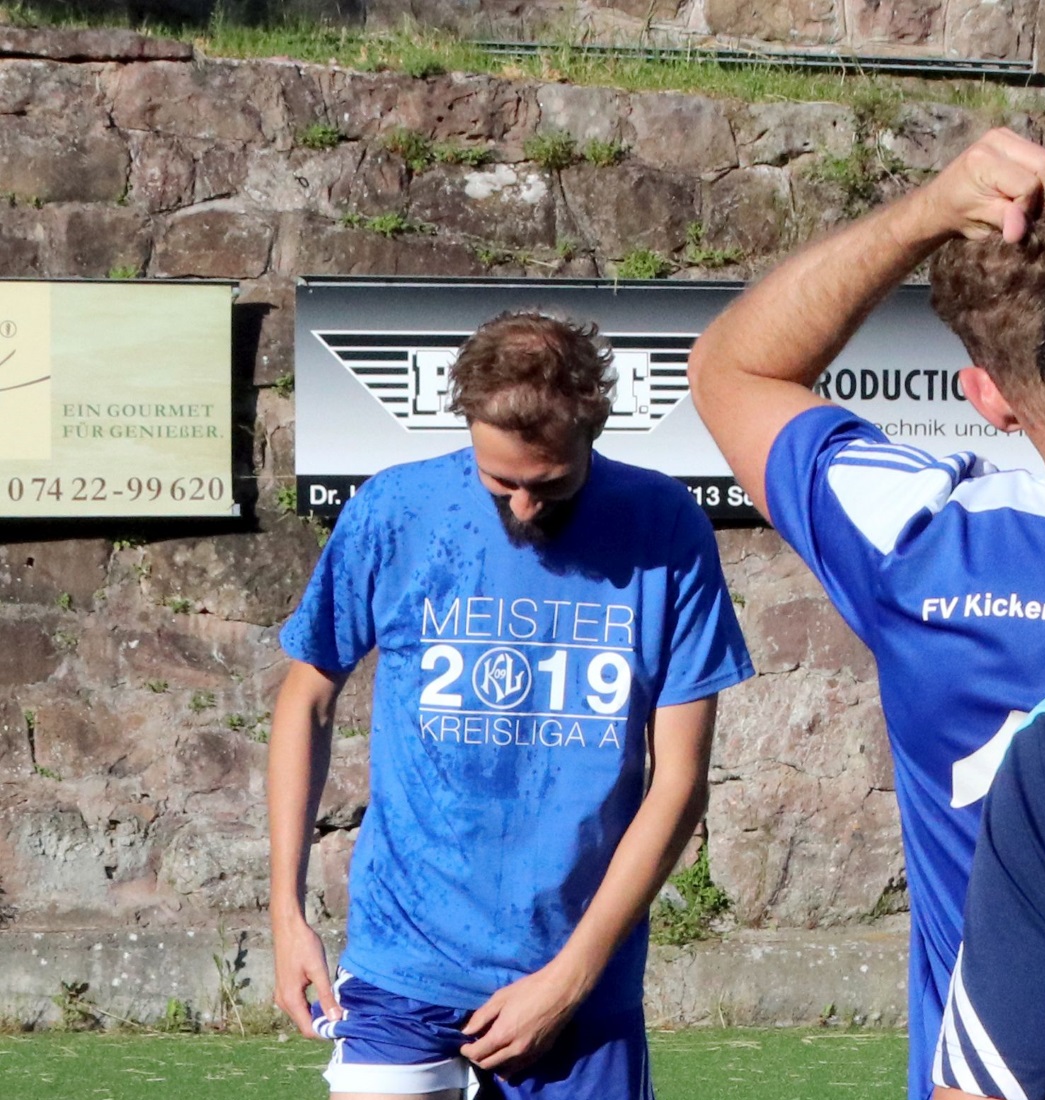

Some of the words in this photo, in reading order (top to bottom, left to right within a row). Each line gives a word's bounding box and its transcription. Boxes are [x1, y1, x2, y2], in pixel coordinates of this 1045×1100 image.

[63, 404, 101, 417] EIN
[107, 404, 214, 417] GOURMET
[62, 421, 104, 438] FÜR
[310, 485, 341, 505] Dr.
[922, 597, 959, 621] FV
[421, 597, 635, 644] MEISTER
[419, 714, 586, 748] KREISLIGA
[599, 723, 621, 749] A
